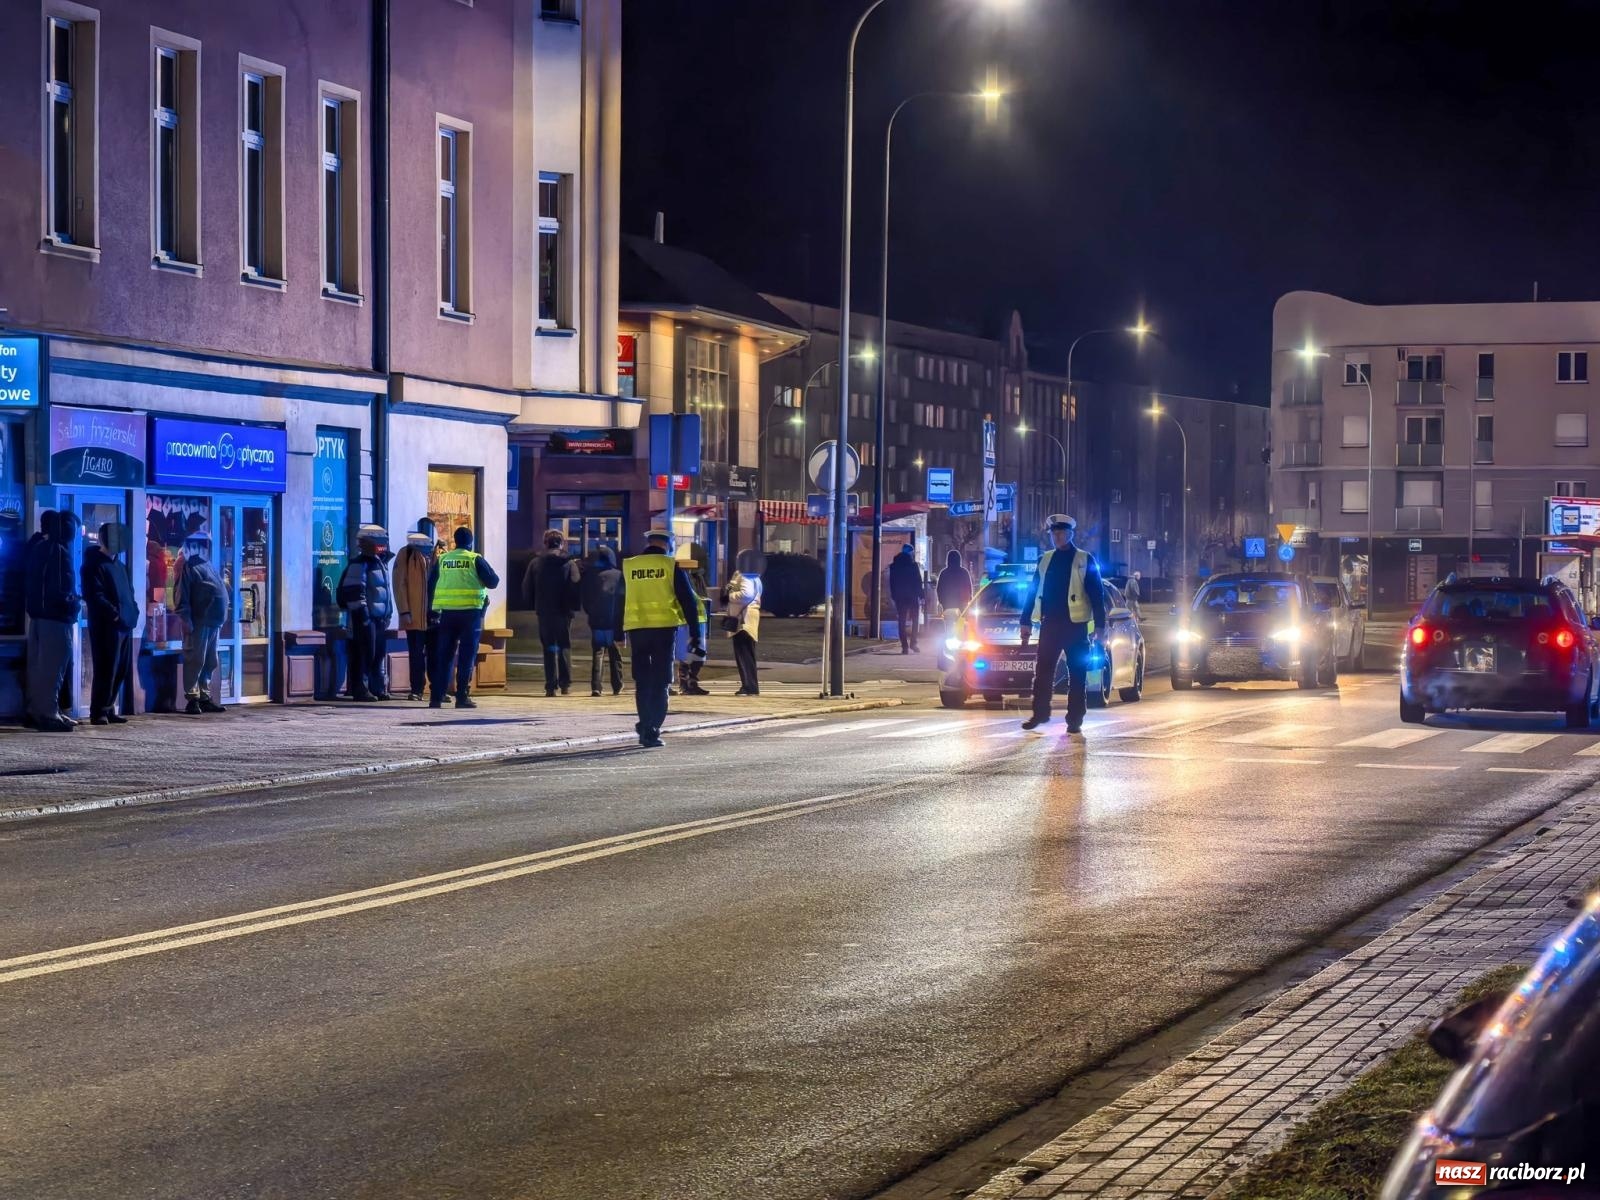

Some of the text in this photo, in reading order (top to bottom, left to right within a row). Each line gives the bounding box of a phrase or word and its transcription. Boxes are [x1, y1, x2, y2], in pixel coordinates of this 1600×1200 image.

[58, 416, 85, 441] Salon
[166, 441, 274, 469] pracownia optyczna
[442, 560, 470, 570] POLICJA
[631, 567, 665, 580] POLICJA
